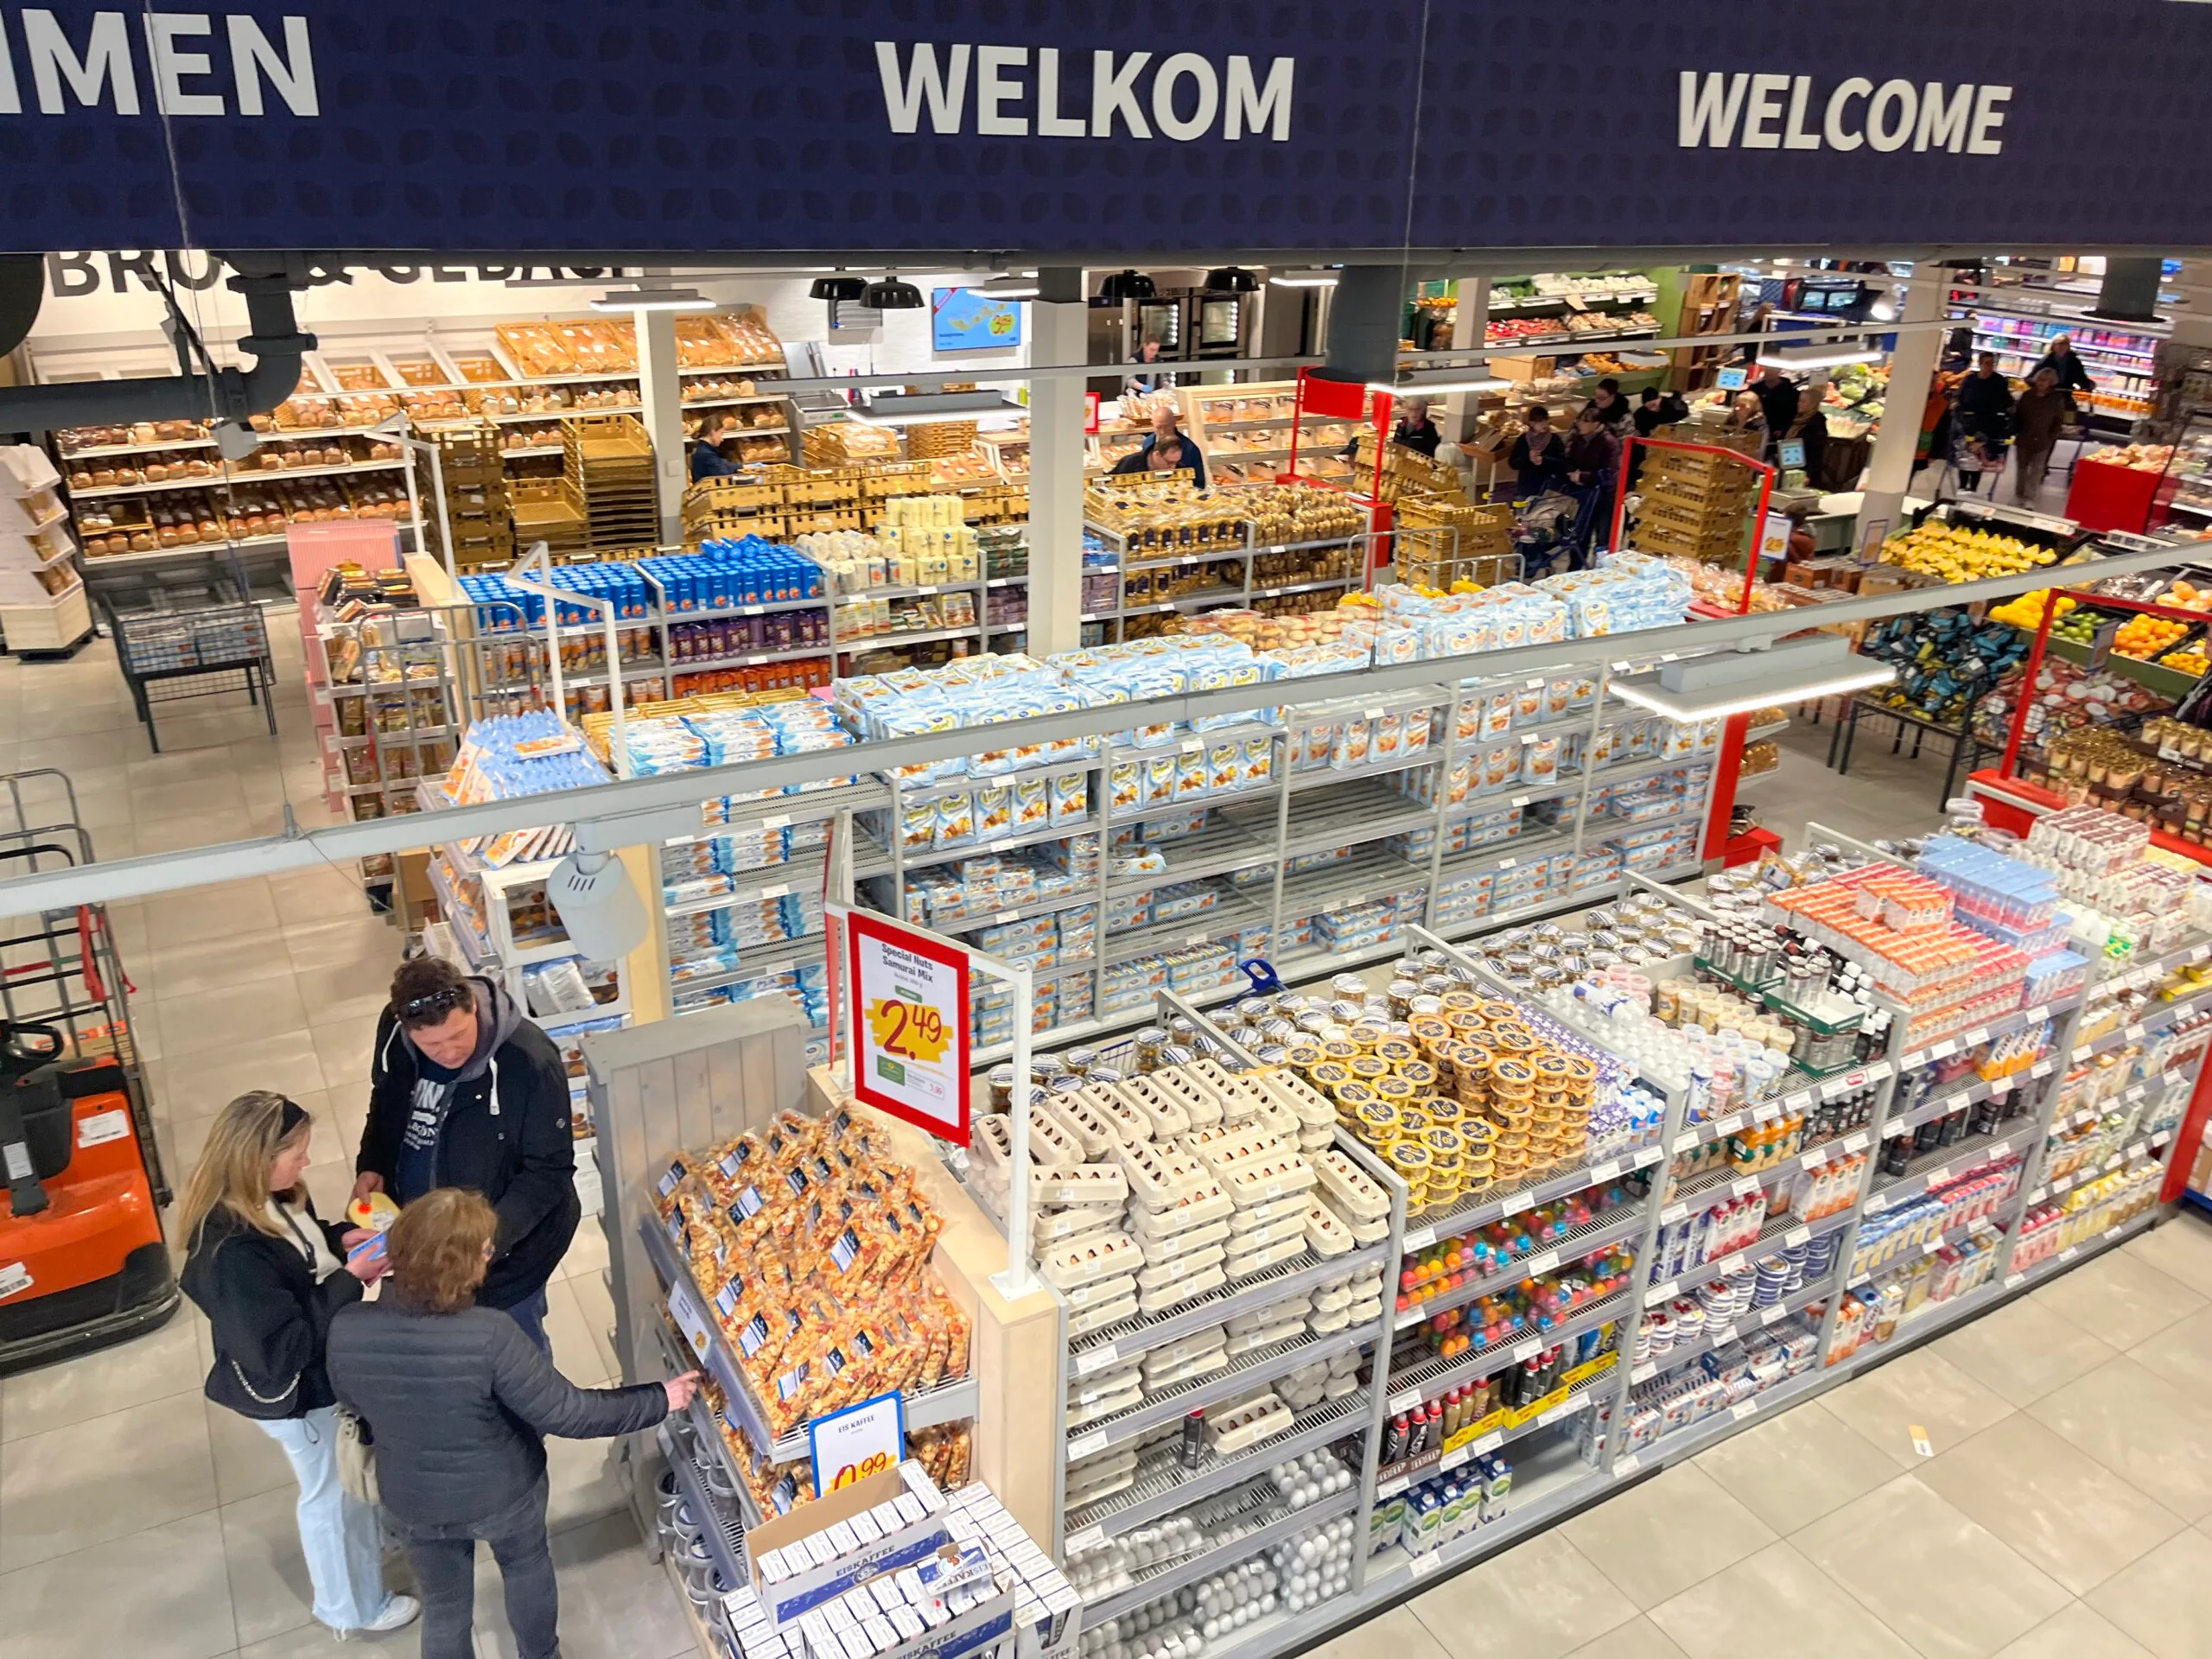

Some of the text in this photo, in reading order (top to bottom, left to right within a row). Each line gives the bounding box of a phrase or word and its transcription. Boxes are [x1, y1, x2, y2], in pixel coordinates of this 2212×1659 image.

[874, 41, 1294, 141] WELKOM
[1678, 71, 2012, 155] WELCOME
[47, 251, 222, 297] BRO
[881, 943, 933, 970] Special Nuts
[882, 956, 916, 976] Samurai
[918, 969, 933, 983] Mix
[881, 1000, 942, 1060] 2.49
[838, 1424, 849, 1433] EIS
[851, 1414, 875, 1428] KAFFEE
[836, 1545, 895, 1578] EISKAFFEE
